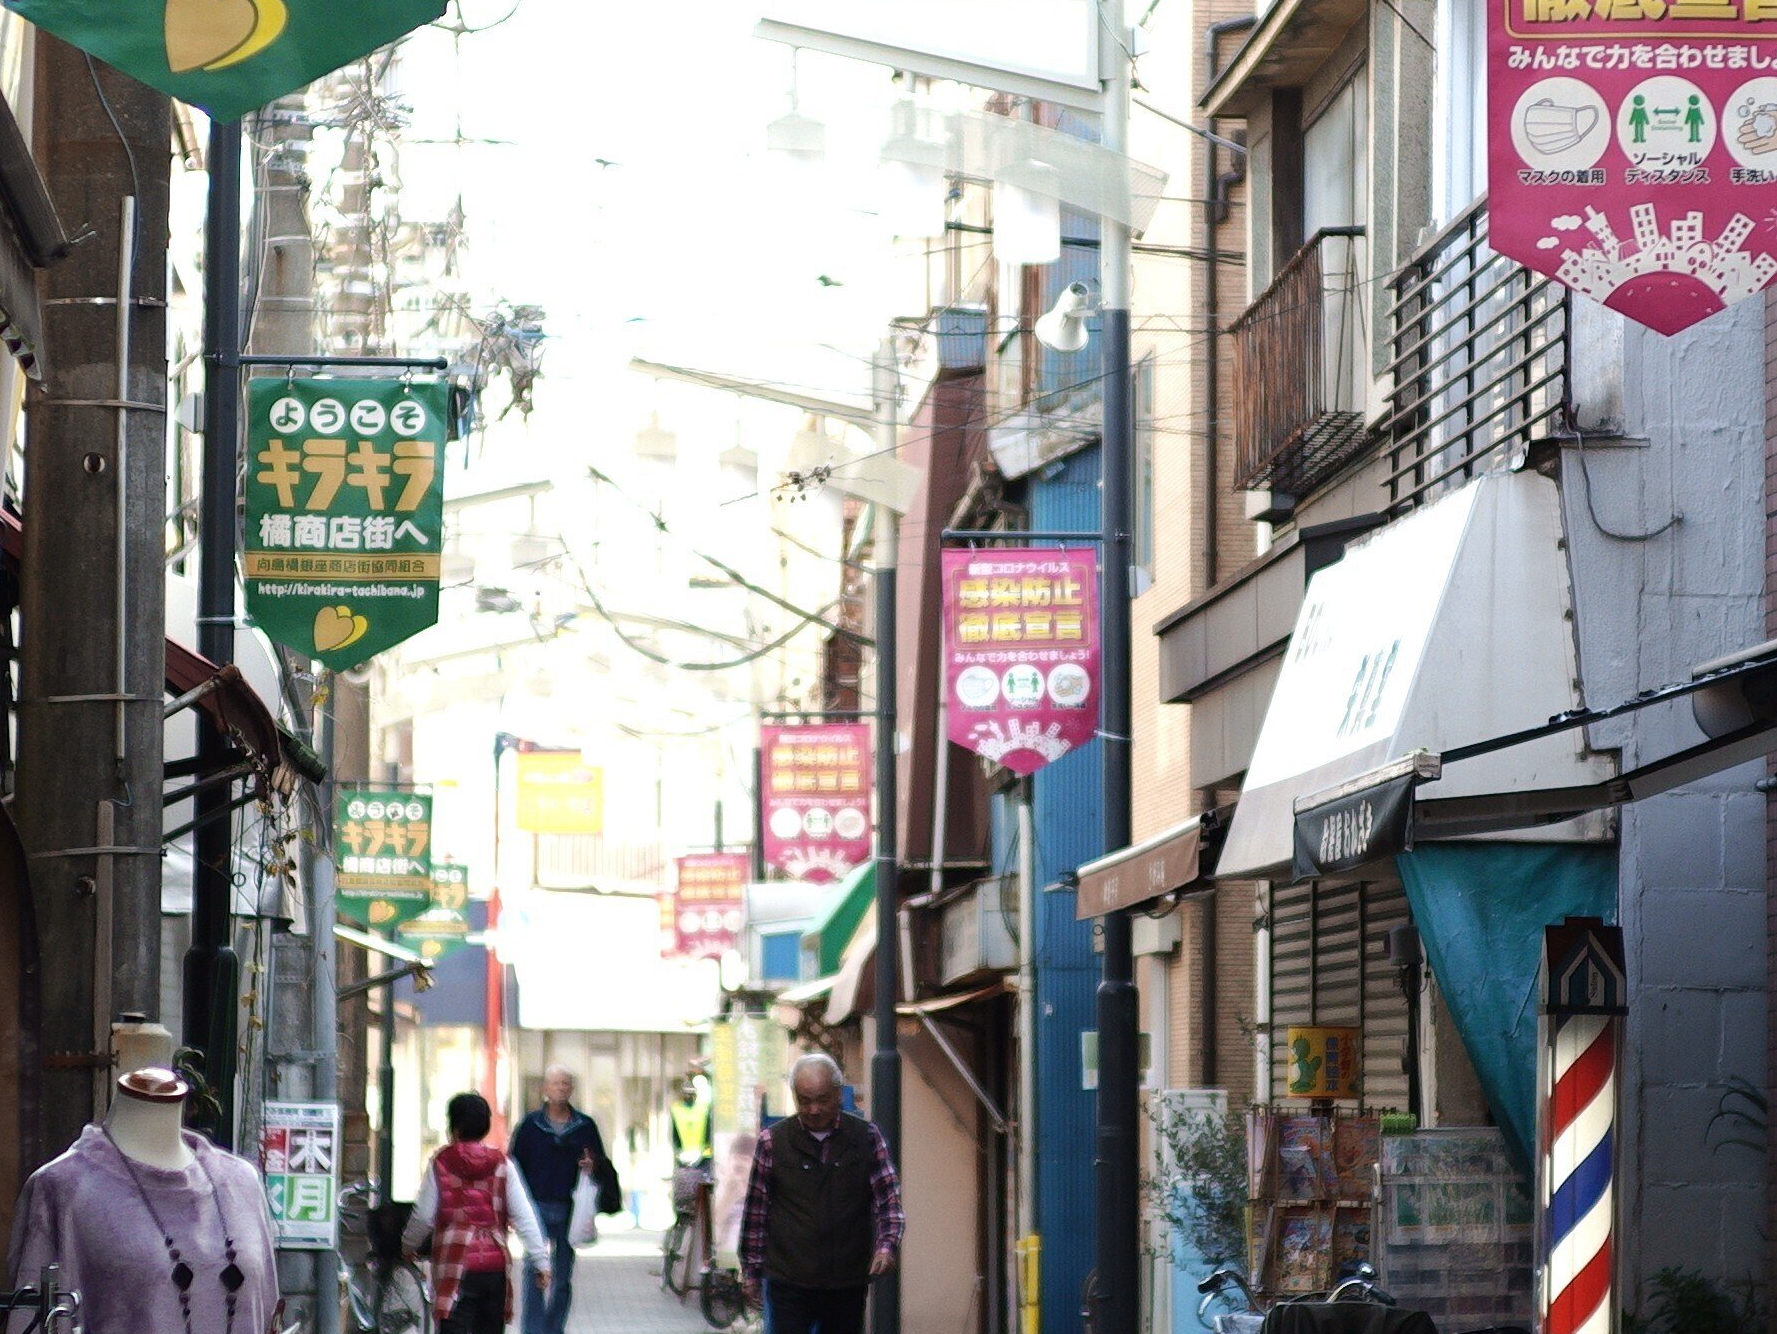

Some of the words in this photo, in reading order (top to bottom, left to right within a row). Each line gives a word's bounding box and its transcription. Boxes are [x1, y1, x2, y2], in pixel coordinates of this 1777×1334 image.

[1633, 152, 1704, 166] ソーシャル
[1518, 168, 1607, 185] マスクの着用
[1625, 168, 1711, 184] ディスタンス
[273, 400, 422, 433] ようこそ
[257, 439, 435, 511] キラキラ
[341, 820, 429, 857] キラキラ
[288, 1177, 327, 1220] 月
